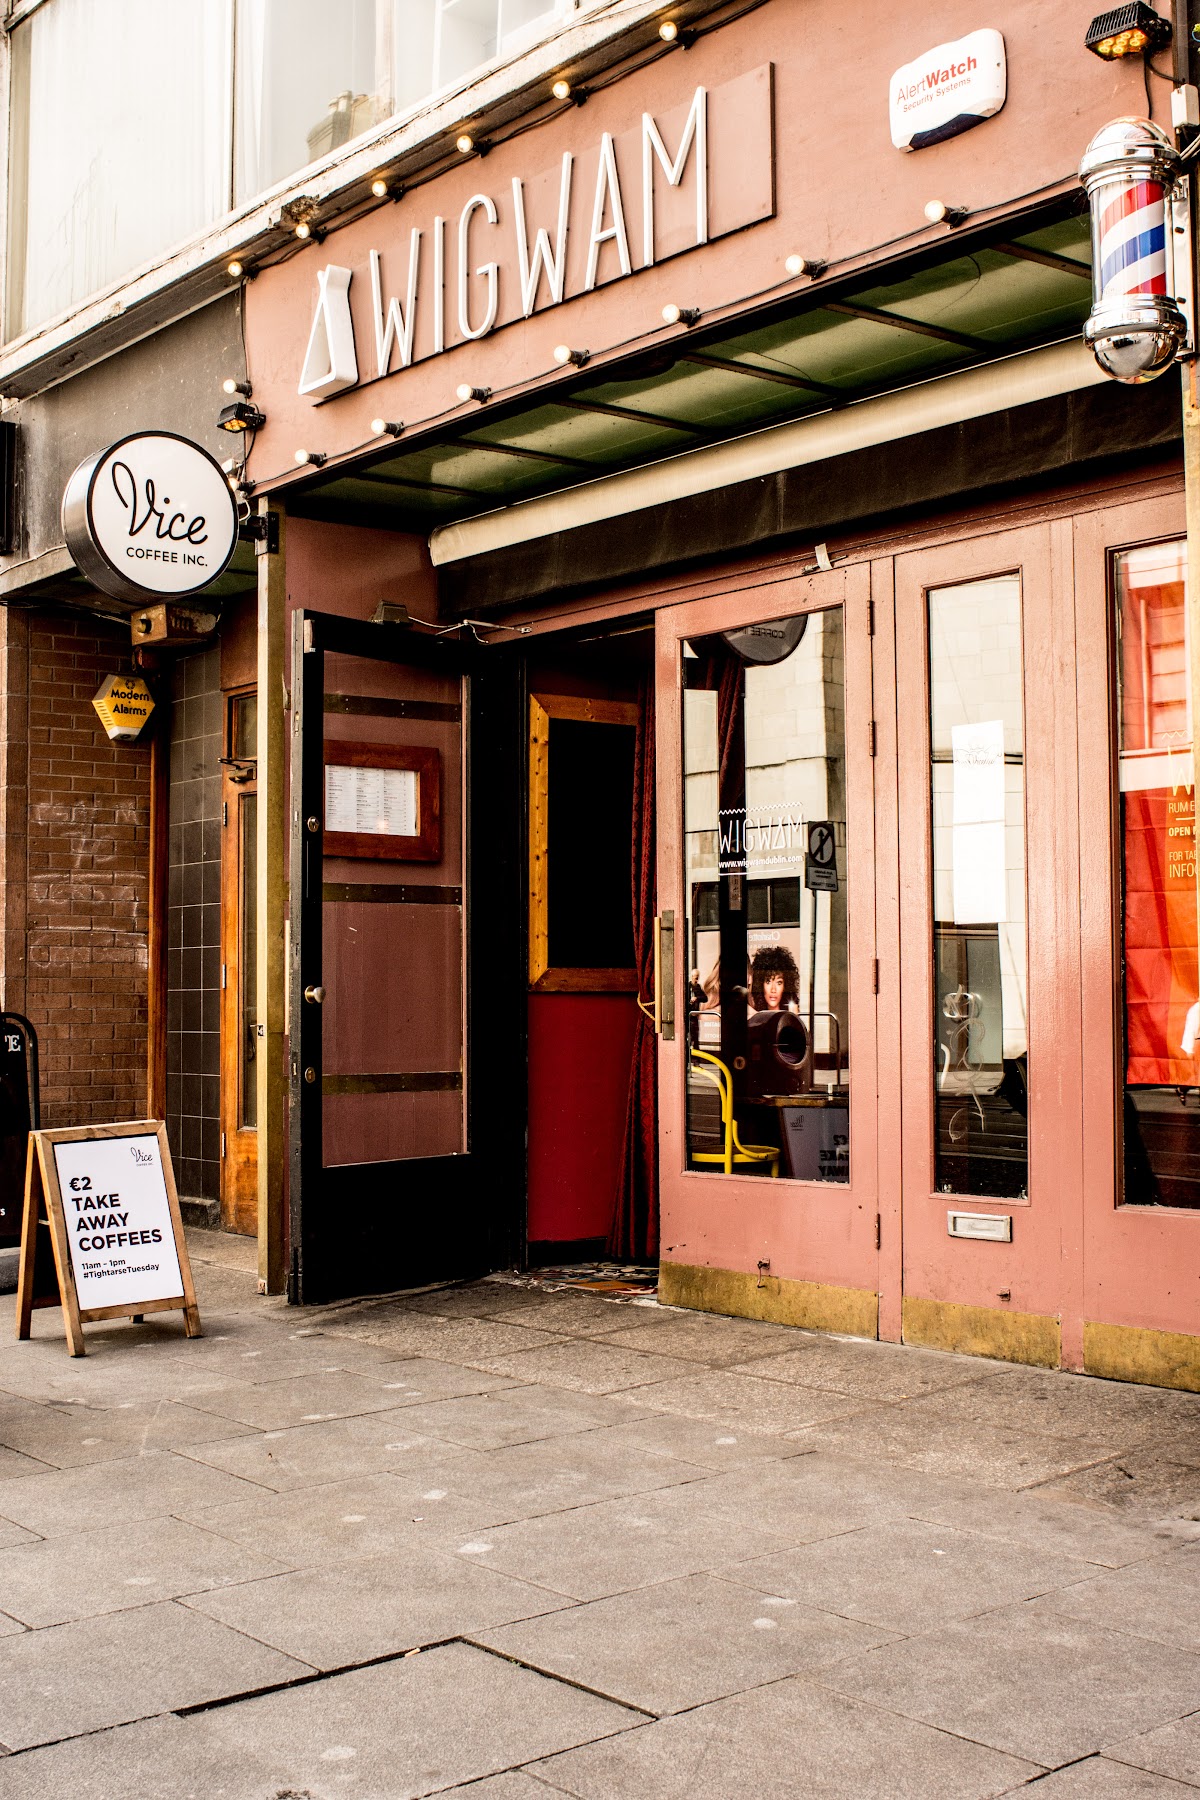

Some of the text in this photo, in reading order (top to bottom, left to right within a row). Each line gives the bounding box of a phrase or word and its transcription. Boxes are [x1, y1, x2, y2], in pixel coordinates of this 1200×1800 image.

[897, 56, 977, 105] AlertWatch
[903, 77, 971, 113] Security Systems
[369, 86, 708, 377] WIGWAM
[112, 461, 208, 545] Vice
[126, 547, 208, 567] COFFEE INC.
[111, 689, 150, 701] Modern
[113, 704, 147, 716] Alarms
[1168, 801, 1189, 814] RUM
[718, 813, 805, 854] WIGWAM
[1168, 826, 1191, 837] OPEN
[718, 854, 804, 869] www.wigwamdublin.com
[1169, 851, 1184, 861] FOR
[130, 1146, 154, 1162] Vice
[69, 1176, 92, 1191] €2
[71, 1193, 121, 1212] TAKE
[76, 1212, 129, 1232] AWAY
[79, 1229, 162, 1251] COFFEES
[81, 1262, 102, 1270] 11am
[109, 1258, 126, 1268] 1pm
[83, 1263, 160, 1279] #TightarseTuesday
